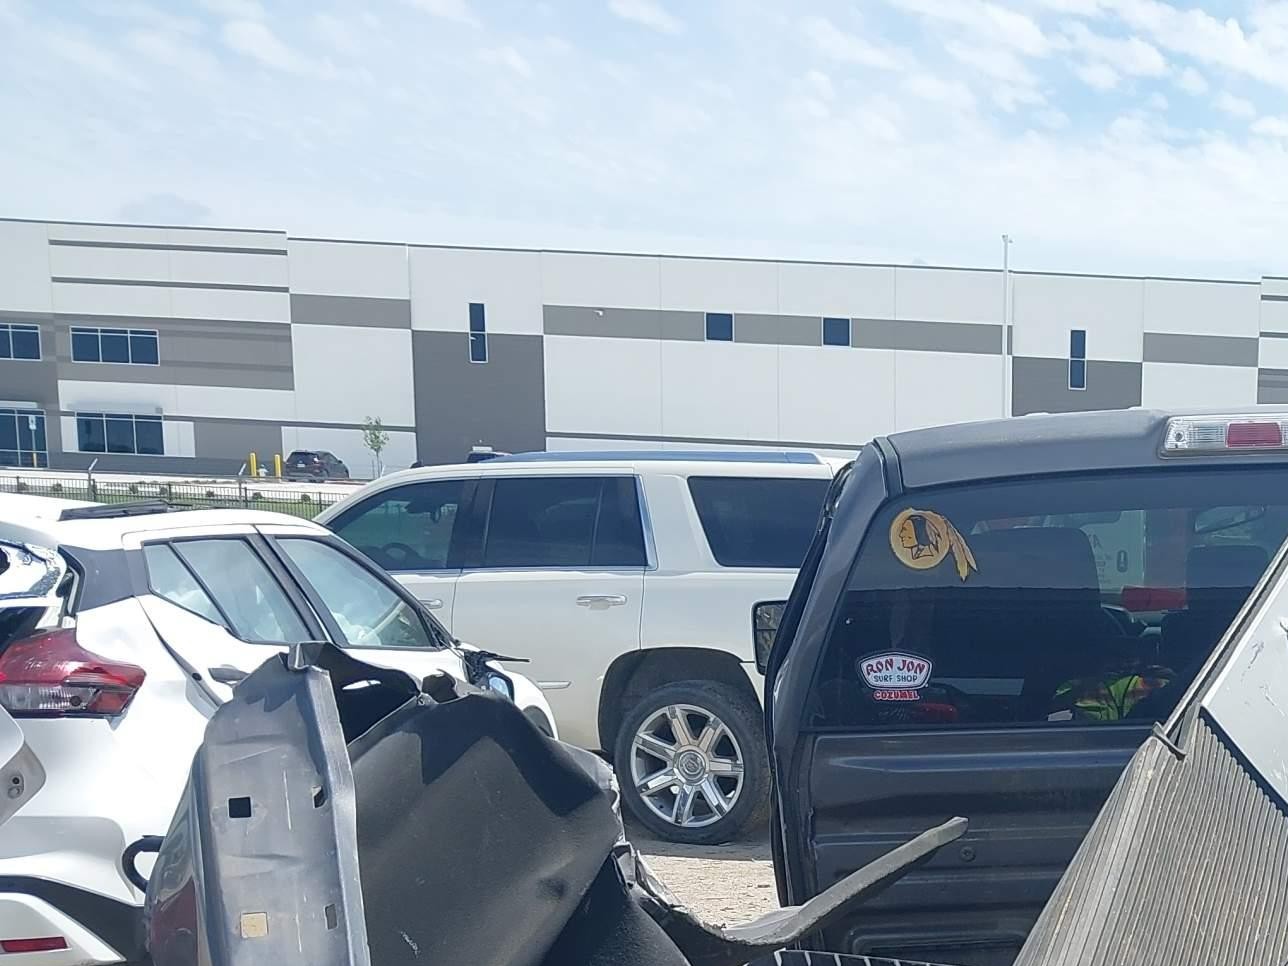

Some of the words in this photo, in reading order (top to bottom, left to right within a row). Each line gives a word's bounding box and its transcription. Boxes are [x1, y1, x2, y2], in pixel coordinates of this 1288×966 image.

[866, 658, 894, 677] RON
[897, 660, 926, 675] JON
[873, 674, 893, 683] SURF
[896, 674, 918, 683] SHOP
[874, 690, 920, 700] COZUMEL
